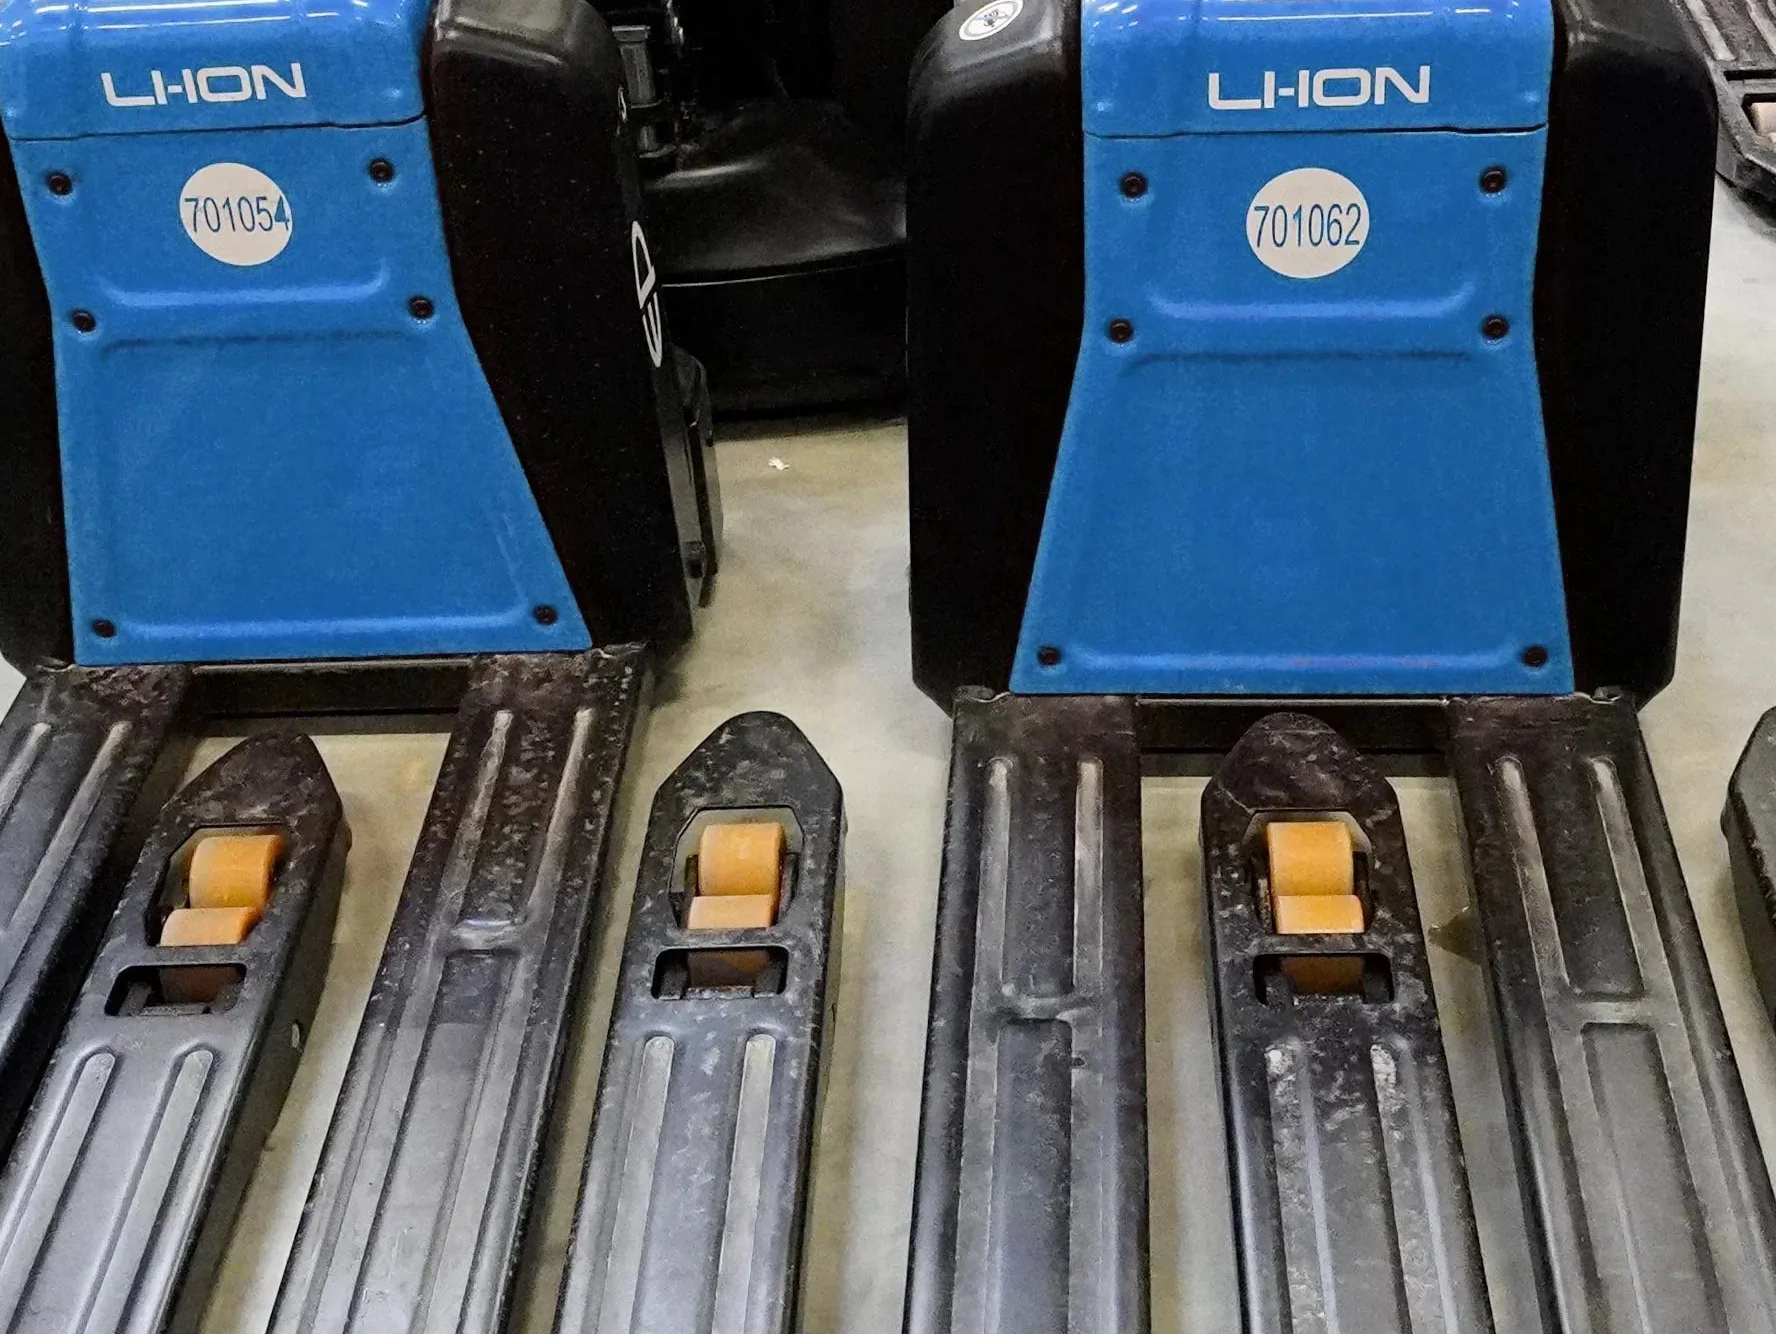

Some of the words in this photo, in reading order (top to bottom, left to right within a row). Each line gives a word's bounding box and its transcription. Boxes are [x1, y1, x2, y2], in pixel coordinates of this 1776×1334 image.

[100, 62, 307, 107] LI-ION
[1208, 65, 1430, 110] LI-ION
[184, 196, 291, 233] 701054
[1253, 203, 1362, 248] 701062
